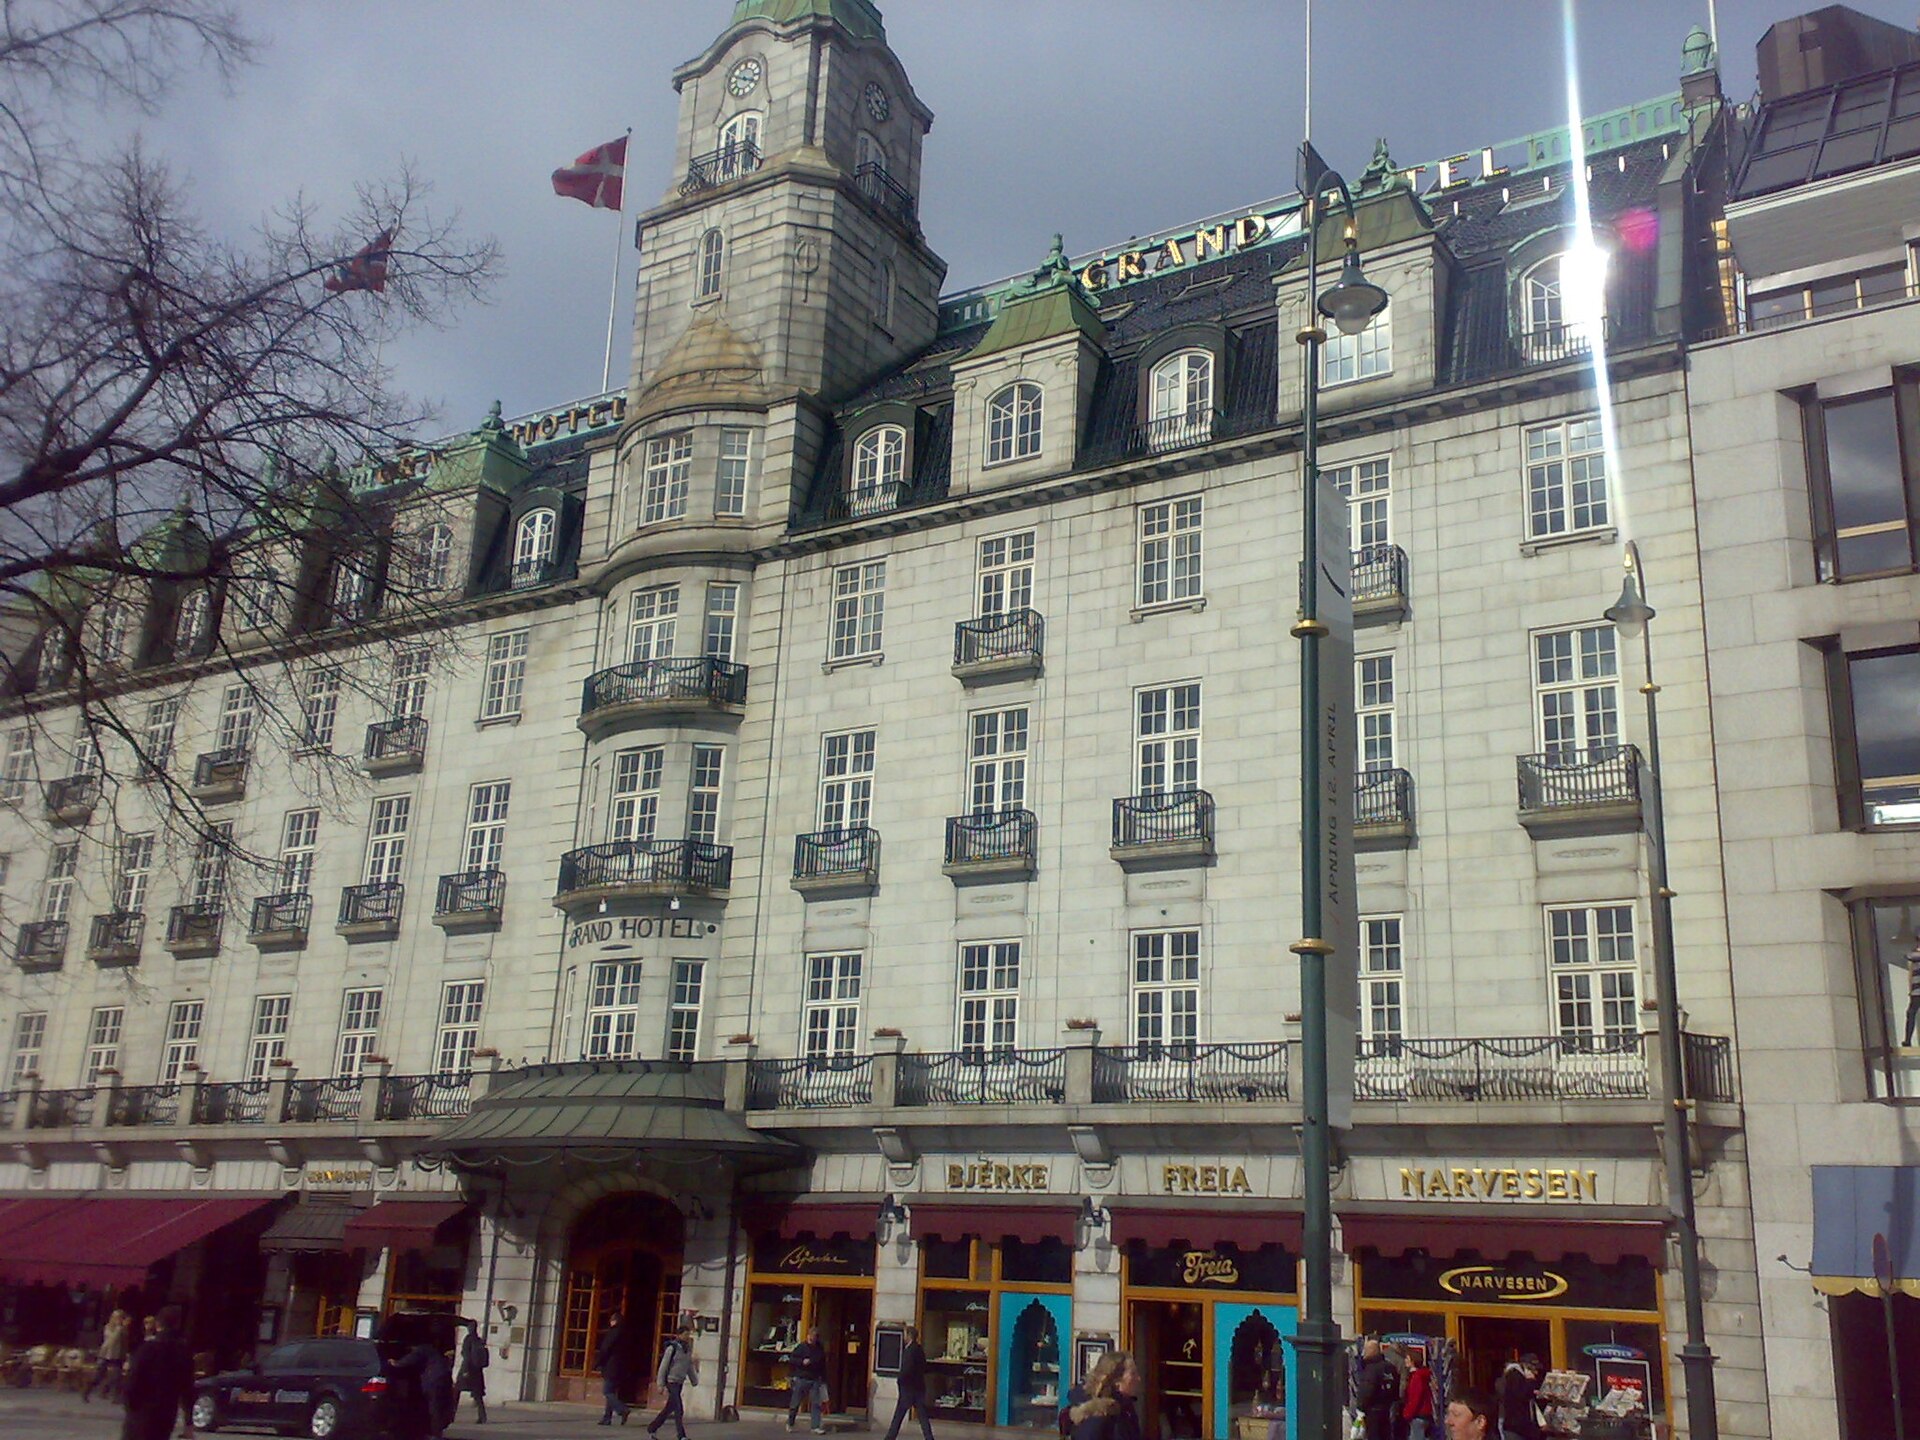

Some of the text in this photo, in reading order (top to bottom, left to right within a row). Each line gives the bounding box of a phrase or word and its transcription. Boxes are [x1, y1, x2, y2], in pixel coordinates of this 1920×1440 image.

[1081, 214, 1269, 292] GRAND
[512, 396, 626, 446] HOTEL
[1327, 702, 1336, 768] APRIL
[569, 917, 703, 948] GRAND HOTEL
[947, 1164, 1049, 1189] BJERKE
[1162, 1165, 1252, 1192] FREIA
[1399, 1167, 1597, 1201] NARVESEN
[1183, 1252, 1239, 1284] Freia
[1460, 1275, 1548, 1291] NARVESEN
